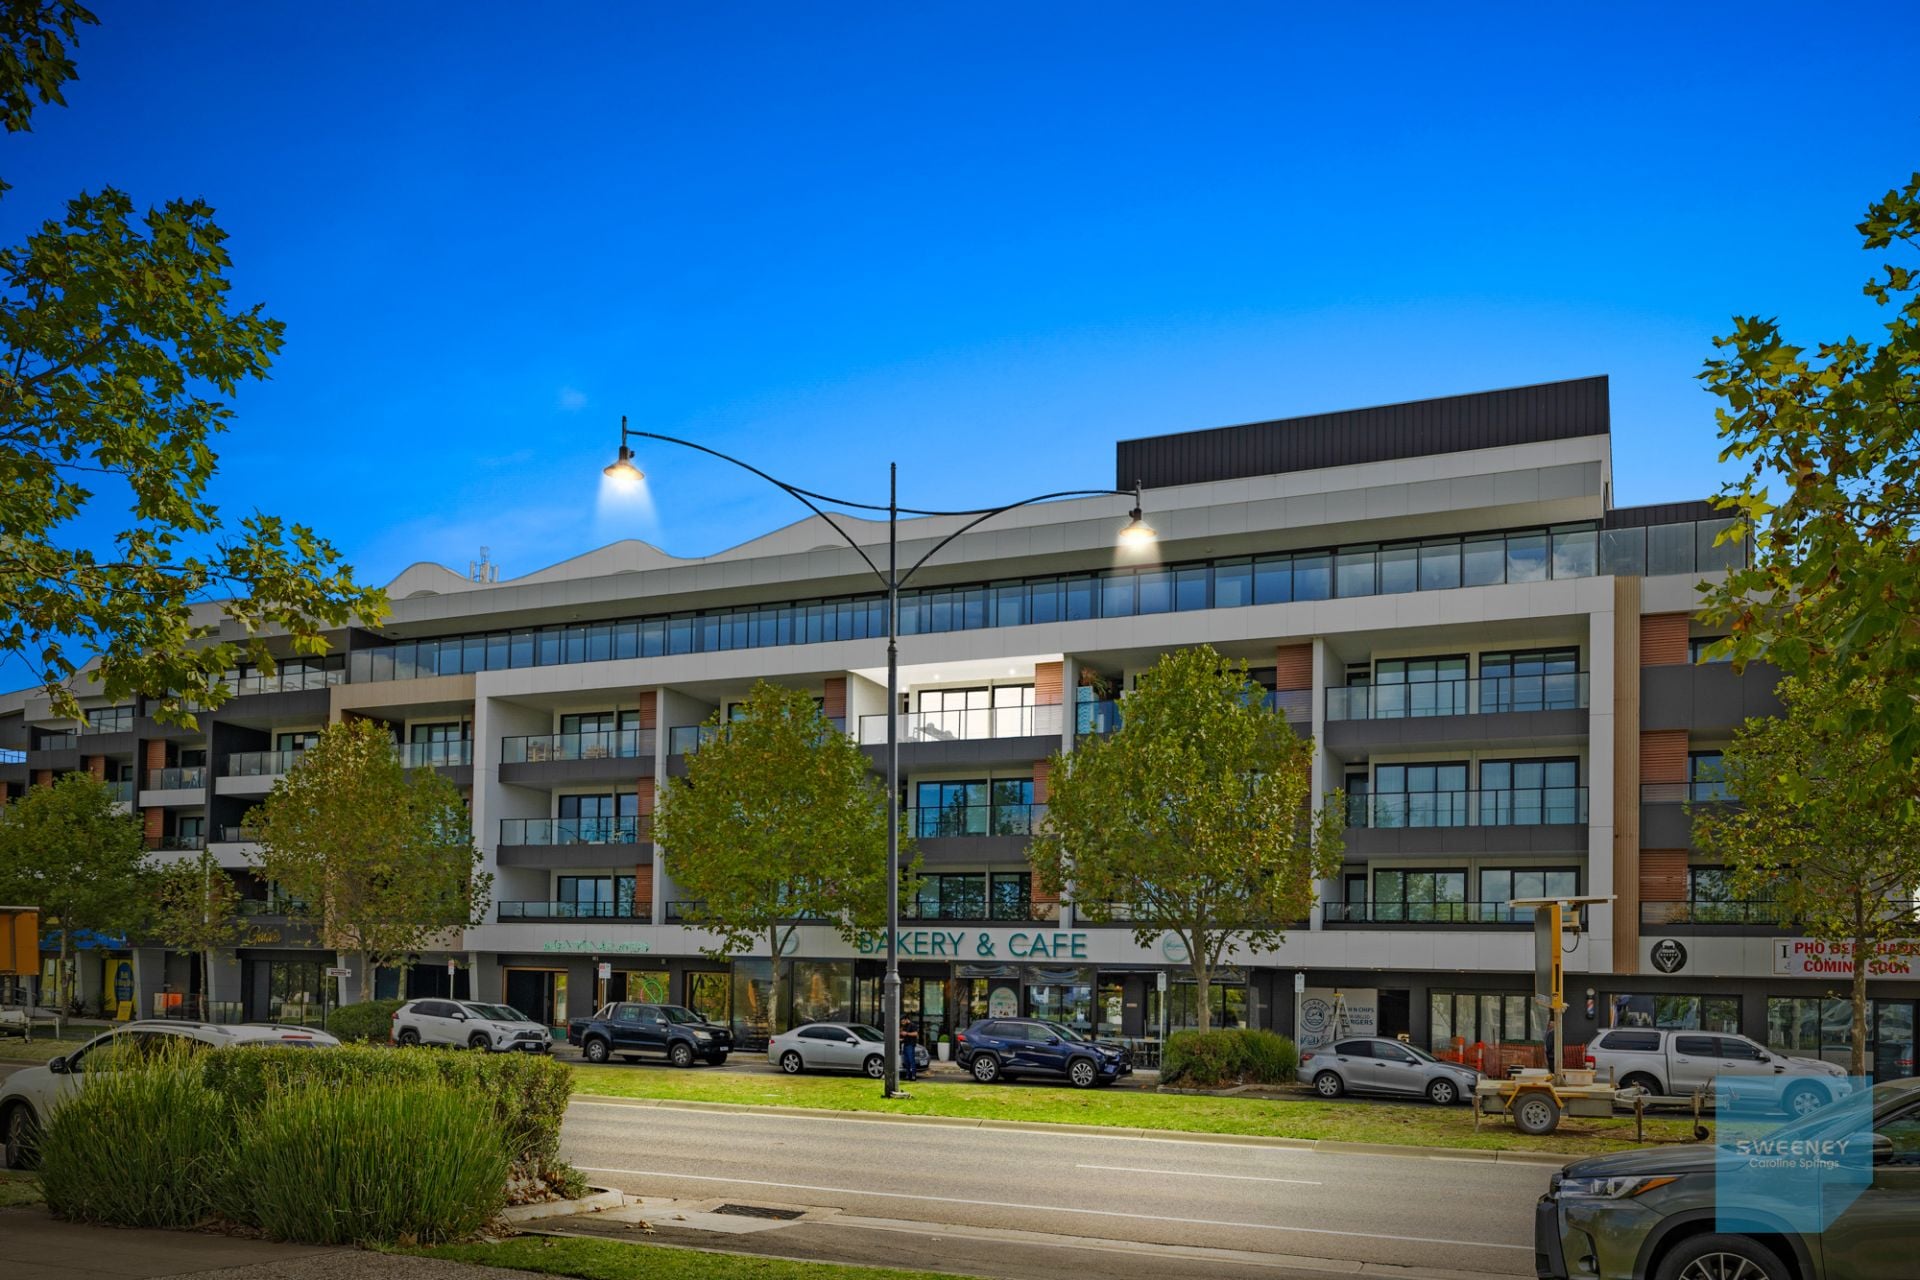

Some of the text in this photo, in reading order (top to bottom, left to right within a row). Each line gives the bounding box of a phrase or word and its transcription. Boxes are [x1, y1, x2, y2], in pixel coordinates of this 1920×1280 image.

[859, 931, 1087, 958] BAKERY & CAFE
[1794, 942, 1825, 954] PHO
[1803, 960, 1862, 973] COMIN
[1868, 960, 1910, 974] SOON
